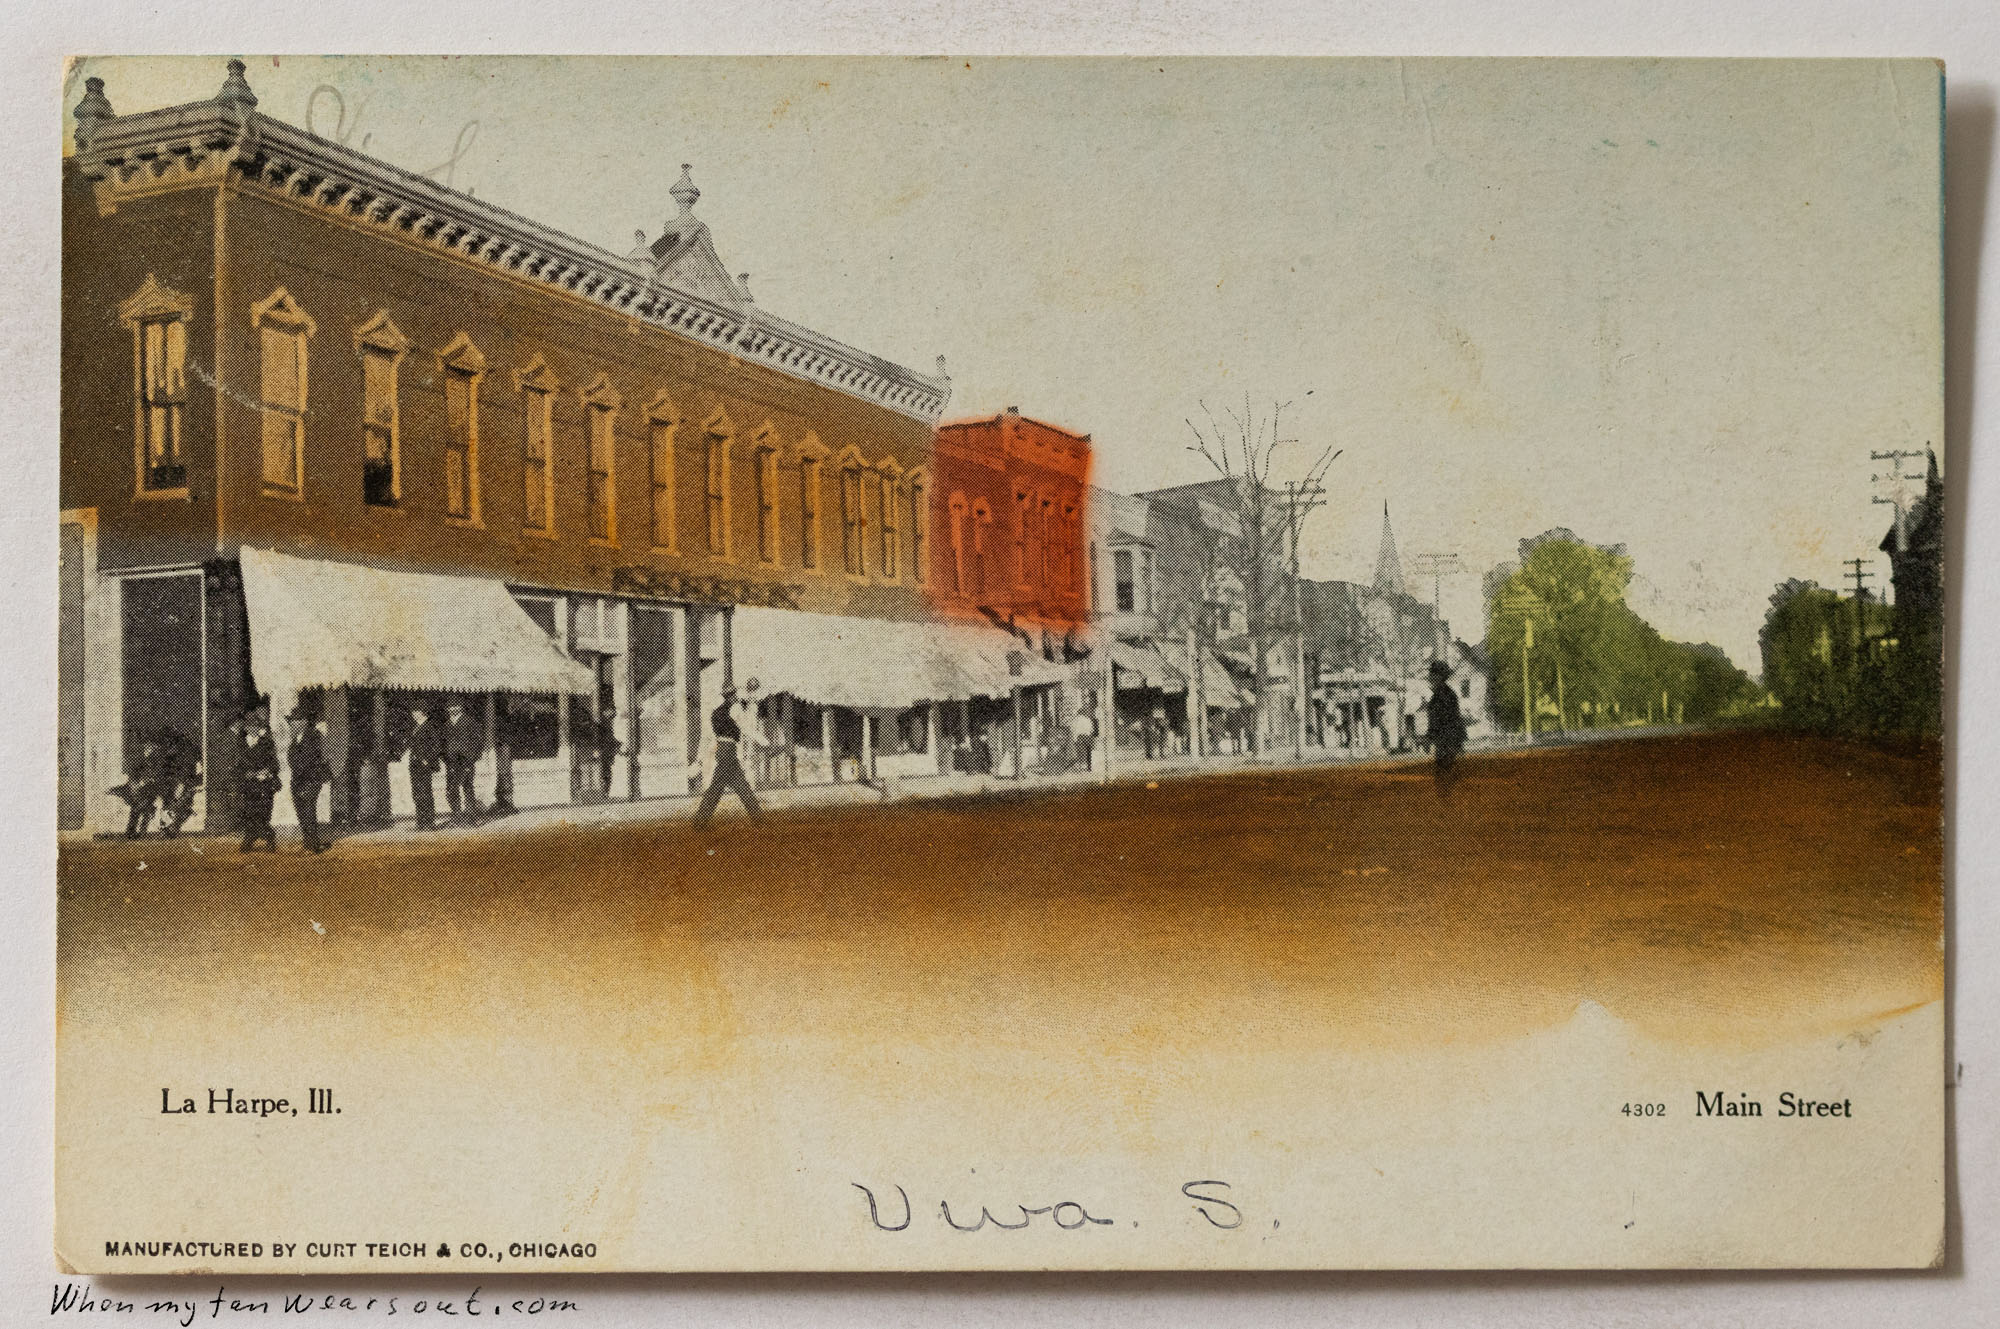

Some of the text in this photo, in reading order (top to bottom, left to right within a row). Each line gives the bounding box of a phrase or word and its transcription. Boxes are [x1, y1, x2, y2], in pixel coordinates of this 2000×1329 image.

[161, 1088, 342, 1117] La Harpe, Ill.
[1620, 1103, 1666, 1118] 4302
[1696, 1091, 1852, 1118] Main Street
[106, 1242, 596, 1262] MANUFACTURED BY CURT TEICH & CO., CHICAGO
